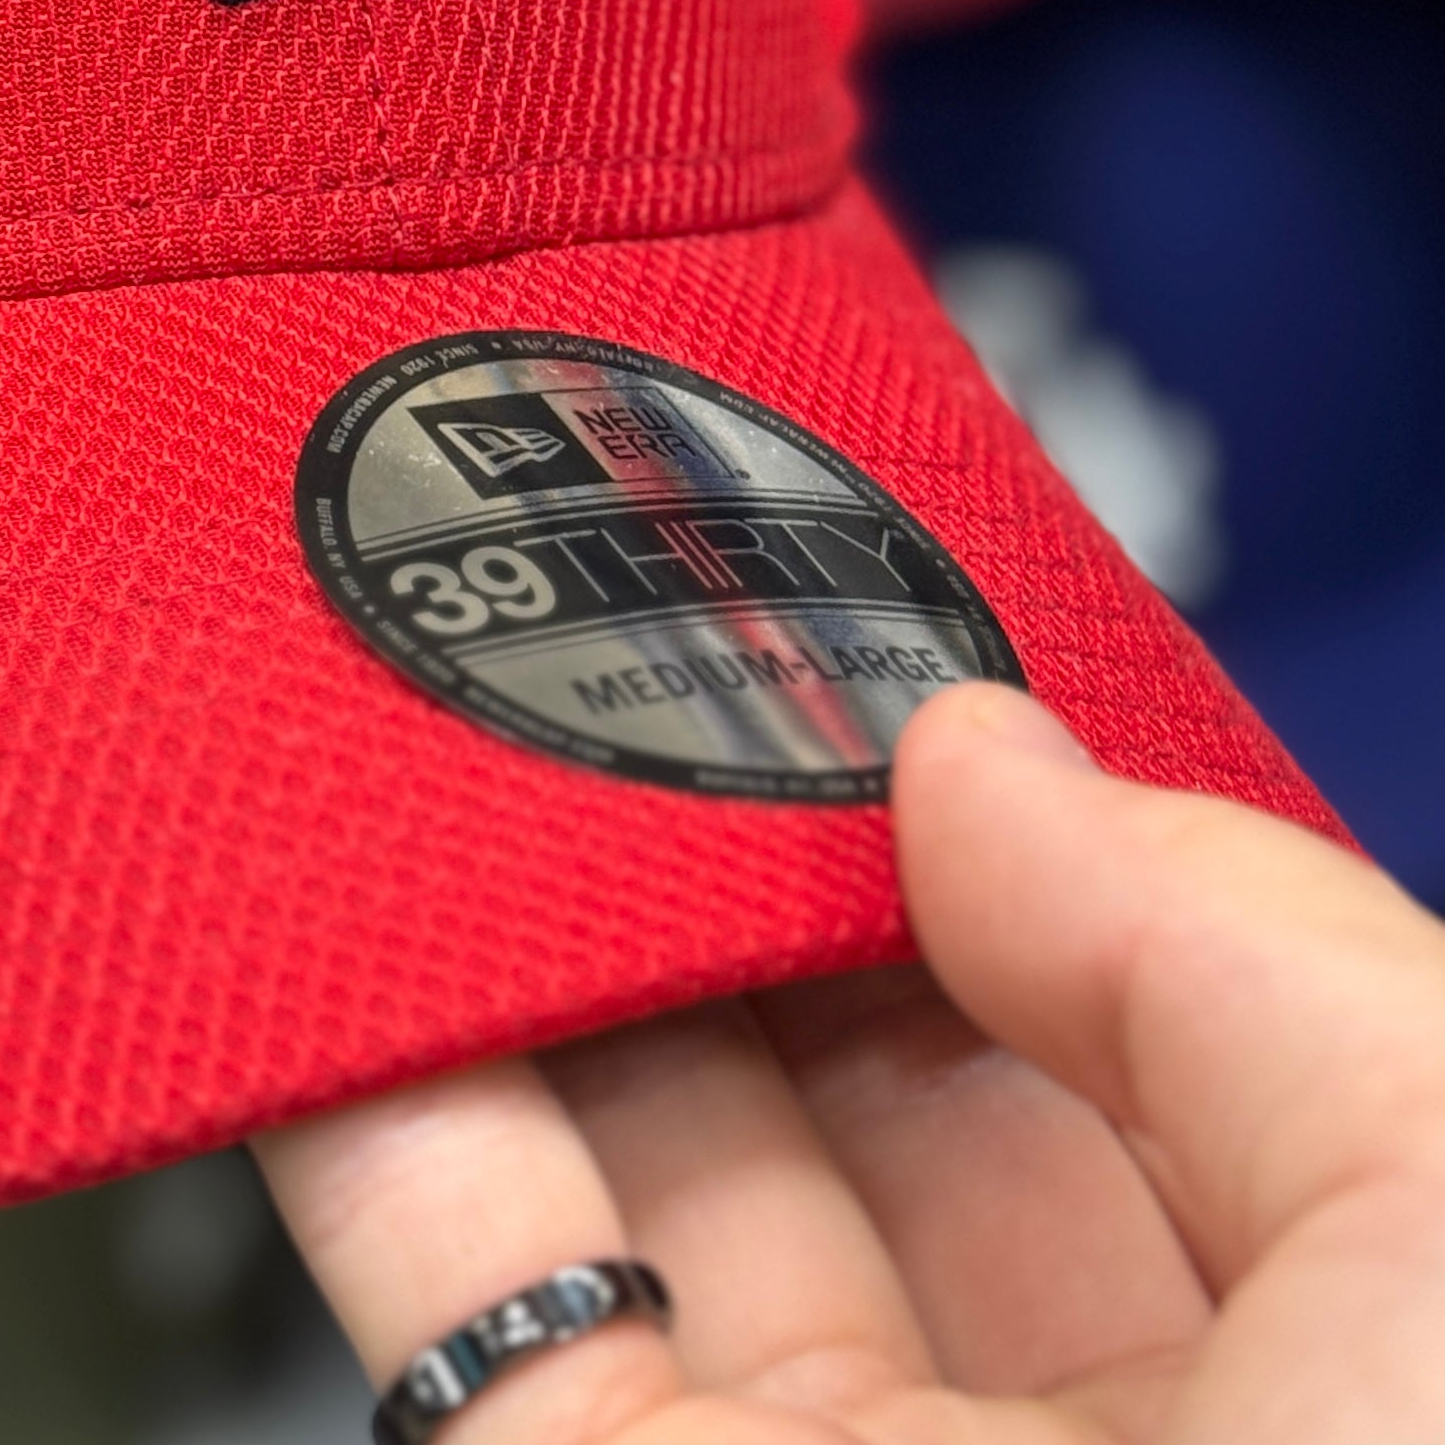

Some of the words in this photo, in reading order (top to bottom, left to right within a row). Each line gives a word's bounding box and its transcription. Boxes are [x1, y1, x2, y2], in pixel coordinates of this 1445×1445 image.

[400, 354, 436, 376] 1920
[326, 375, 398, 454] NEWERACAP.COM
[572, 406, 672, 435] NEW
[598, 432, 698, 460] ERA
[325, 552, 347, 570] NY
[338, 575, 363, 599] USA
[389, 517, 911, 636] 39THIRTY
[570, 645, 959, 716] MEDIUM-LARGE
